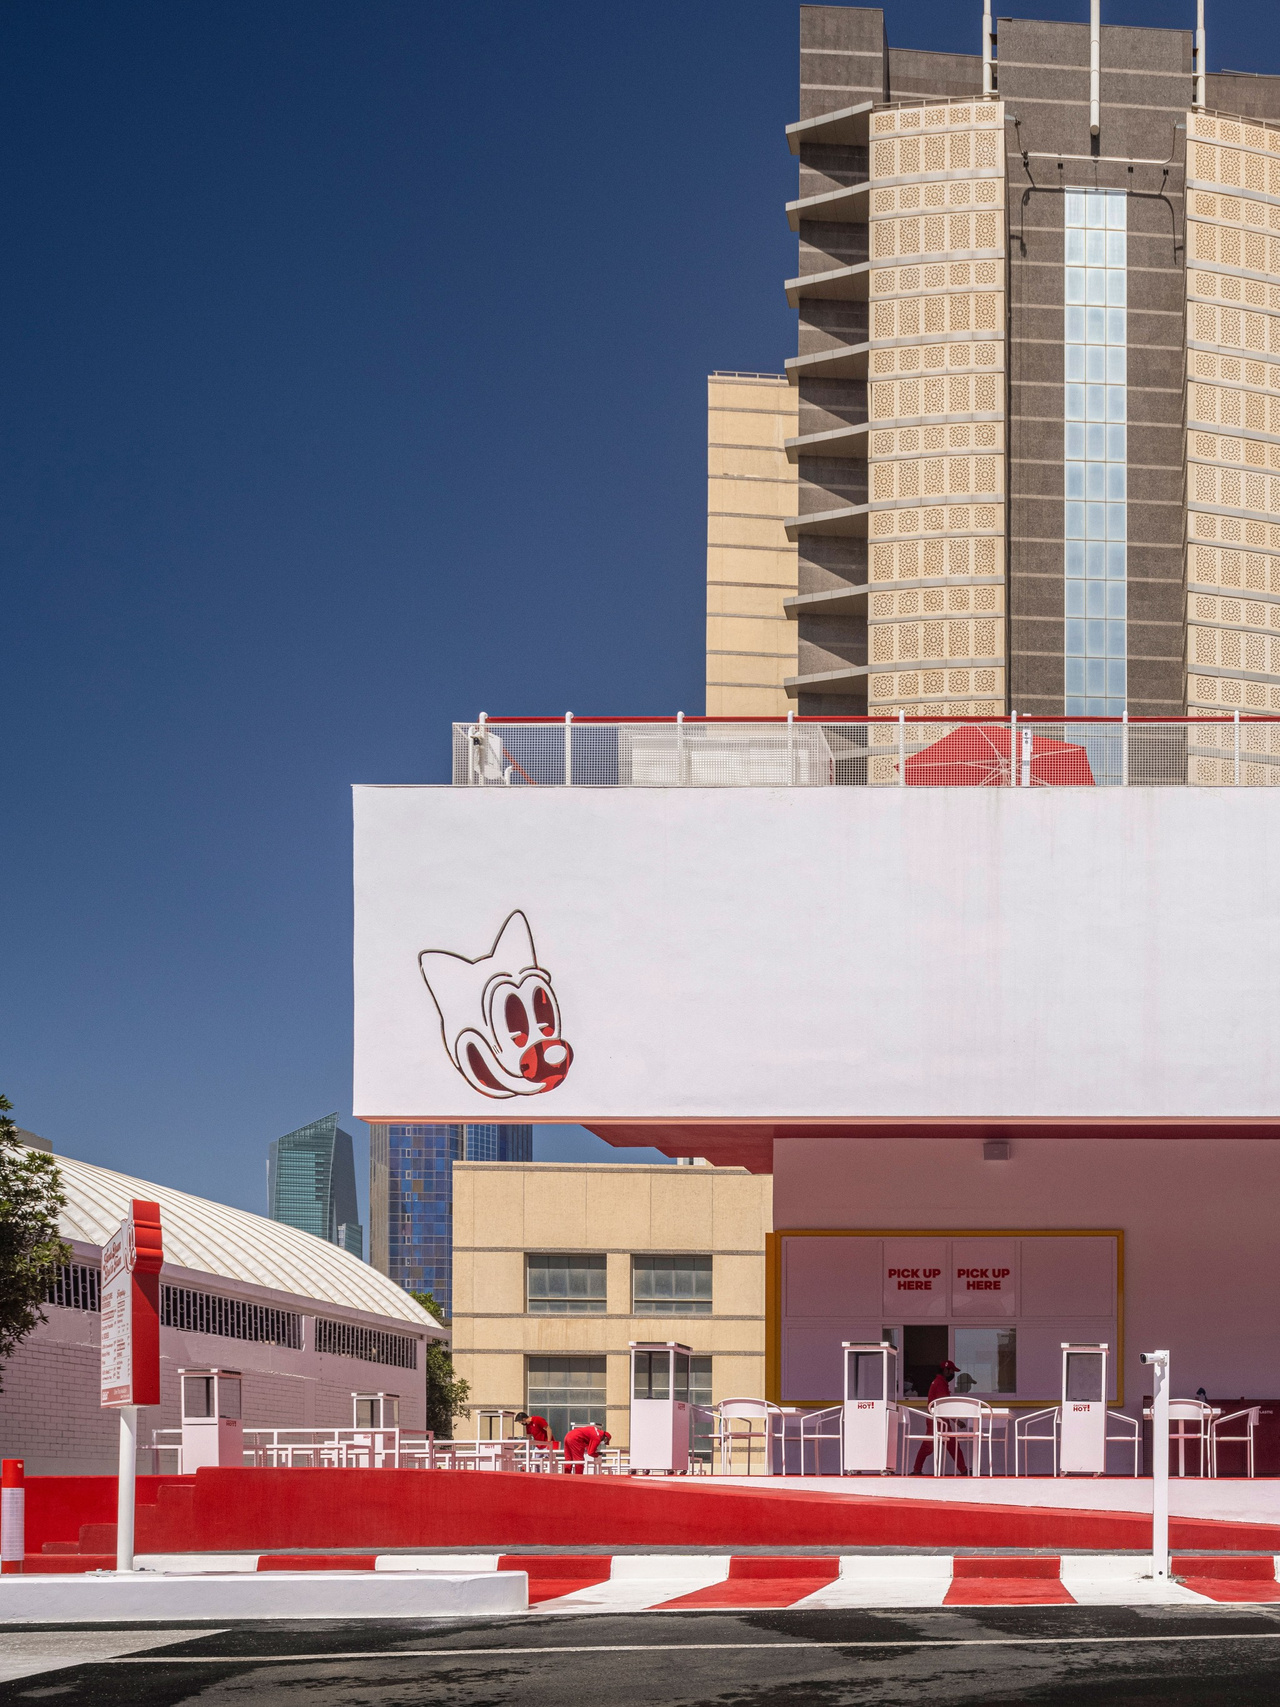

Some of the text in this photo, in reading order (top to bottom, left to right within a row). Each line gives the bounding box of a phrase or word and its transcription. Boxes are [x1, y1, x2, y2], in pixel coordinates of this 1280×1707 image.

[888, 1269, 941, 1278] PICK UP
[957, 1269, 1010, 1278] PICK UP
[897, 1281, 932, 1290] HERE
[966, 1281, 1001, 1290] HERE
